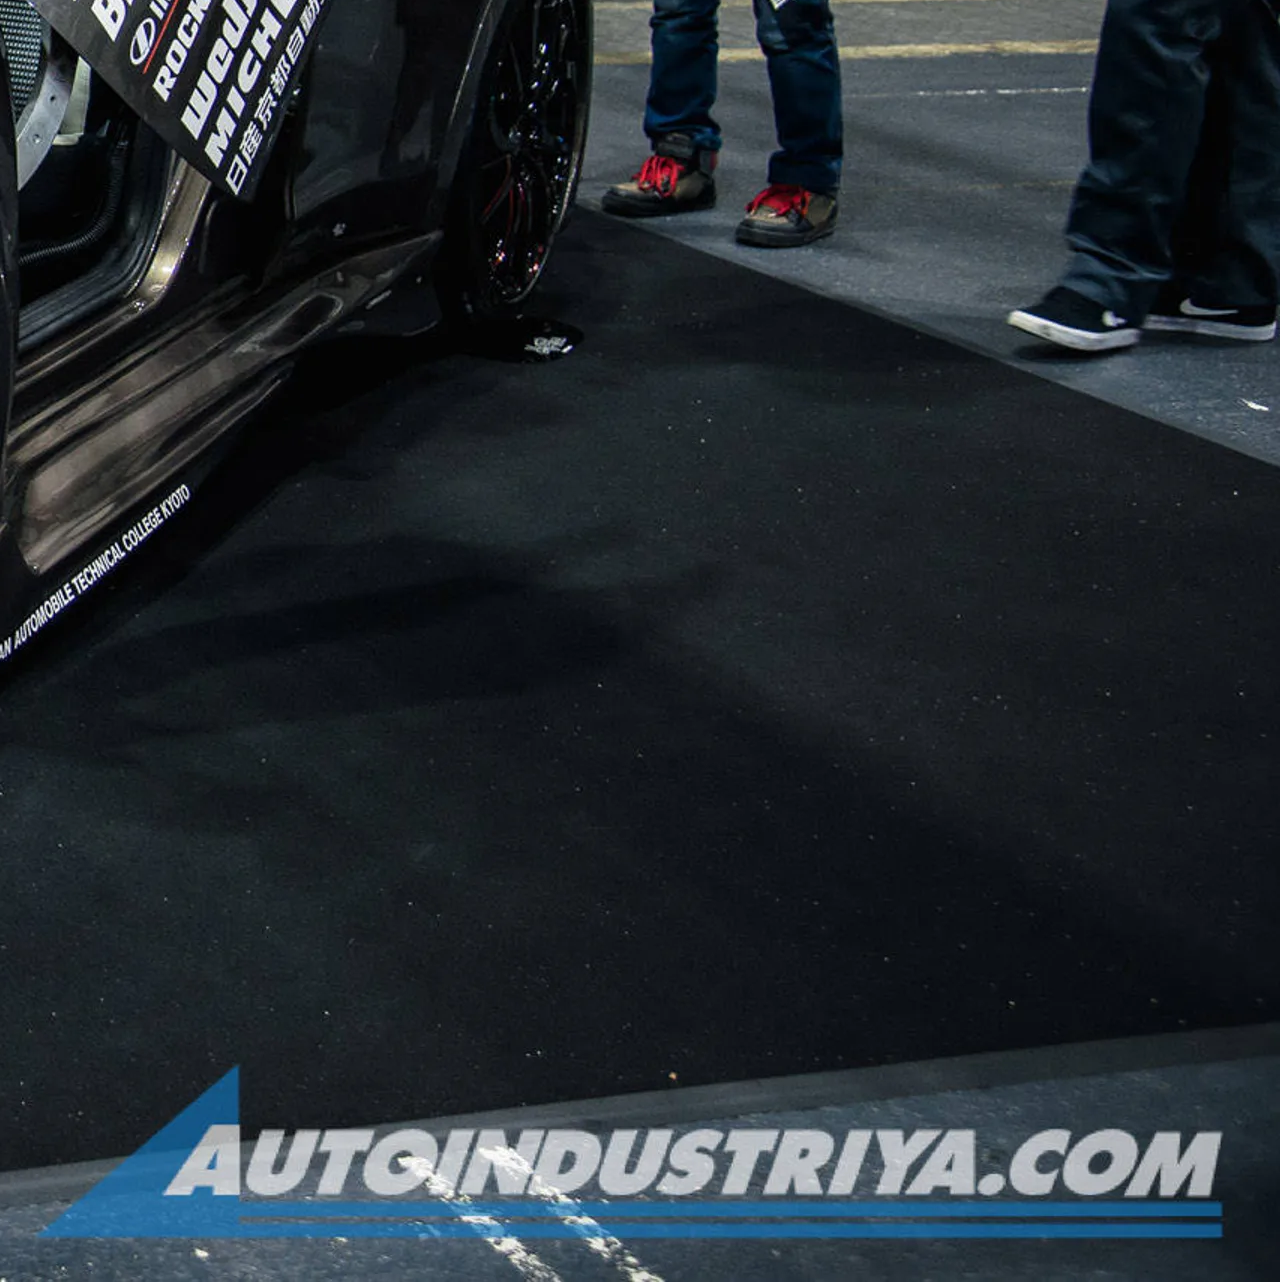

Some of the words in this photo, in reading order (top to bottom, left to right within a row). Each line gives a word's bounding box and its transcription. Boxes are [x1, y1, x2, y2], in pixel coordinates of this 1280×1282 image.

[13, 582, 75, 650] AUTOMOBILE
[71, 541, 126, 595] TECHNICAL
[121, 507, 164, 552] COLLEGE
[160, 484, 191, 520] KYOTO
